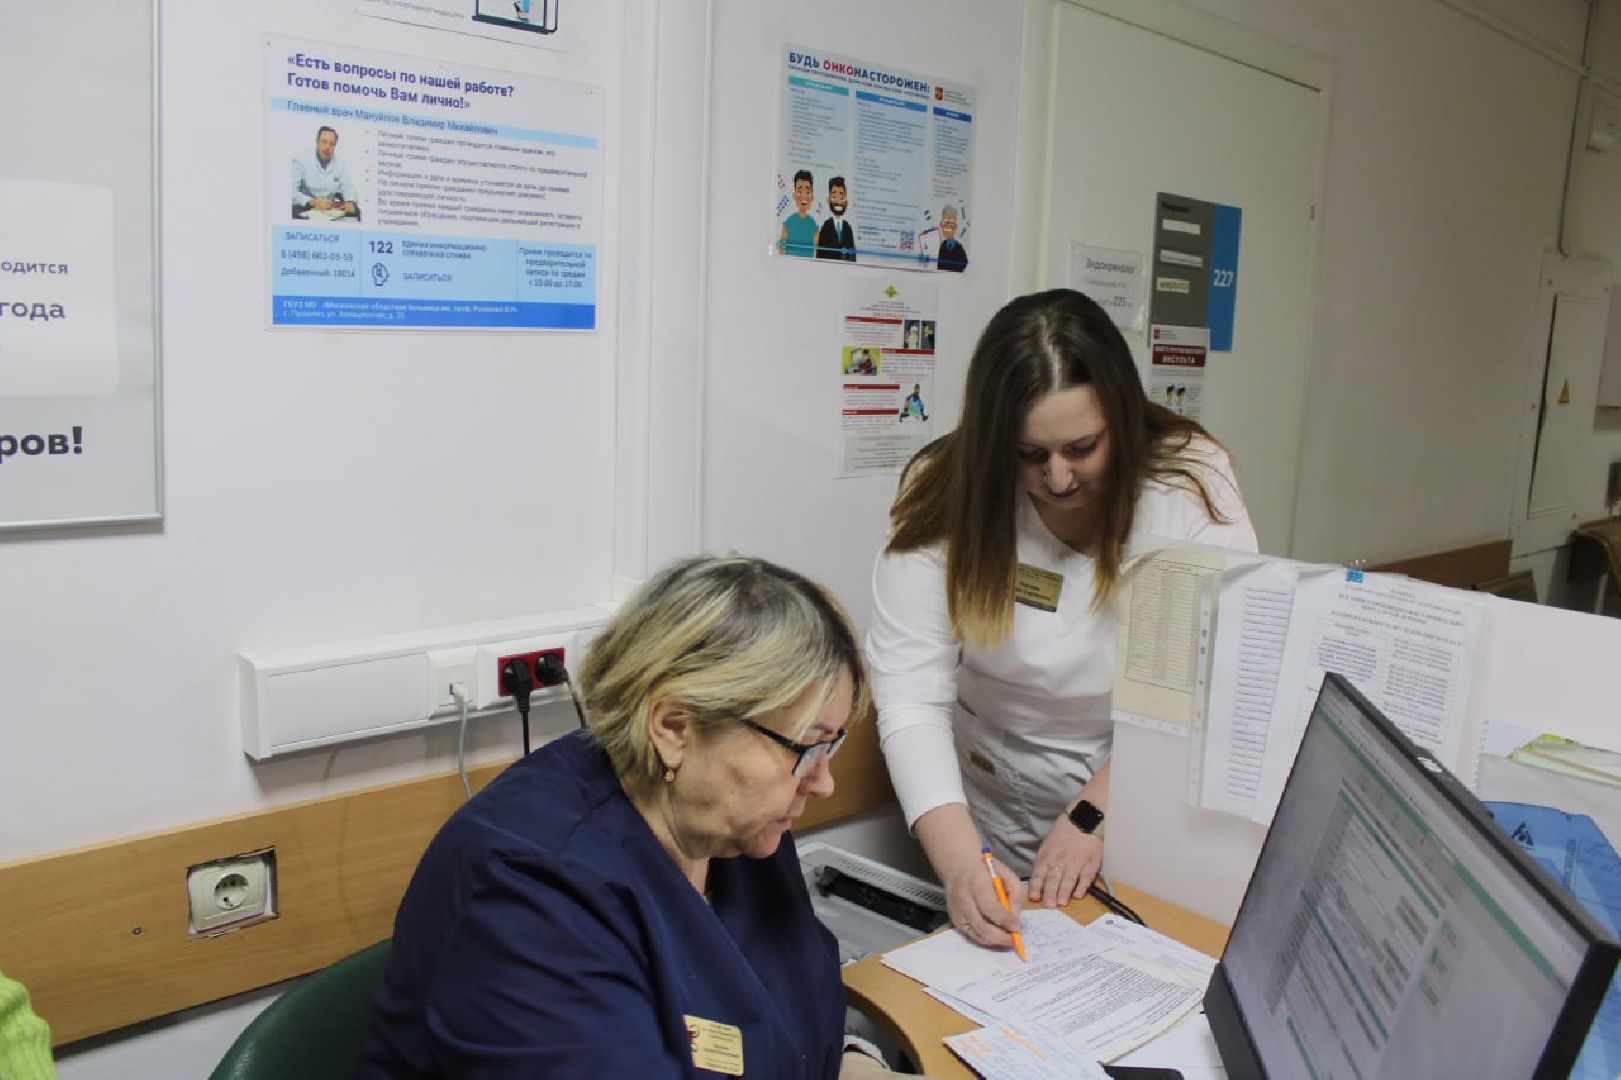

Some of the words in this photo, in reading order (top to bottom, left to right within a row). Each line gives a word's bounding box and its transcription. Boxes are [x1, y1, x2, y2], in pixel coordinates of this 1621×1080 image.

[789, 53, 820, 68] БУДЬ
[287, 53, 330, 70] «Есть
[334, 62, 396, 81] вопросы
[400, 70, 416, 83] по
[419, 74, 460, 89] нашей
[465, 81, 514, 98] работе?
[287, 73, 329, 89] Готов
[333, 82, 386, 98] помочь
[391, 87, 417, 103] Вам
[421, 93, 471, 109] лично!»
[287, 101, 329, 115] Главный
[402, 115, 445, 130] Владимир
[448, 120, 497, 135] Михайлович
[285, 231, 340, 242] ЗАПИСАТЬСЯ
[369, 240, 393, 254] 122
[402, 272, 453, 282] ЗАПИСАТЬСЯ
[1213, 269, 1233, 287] 227
